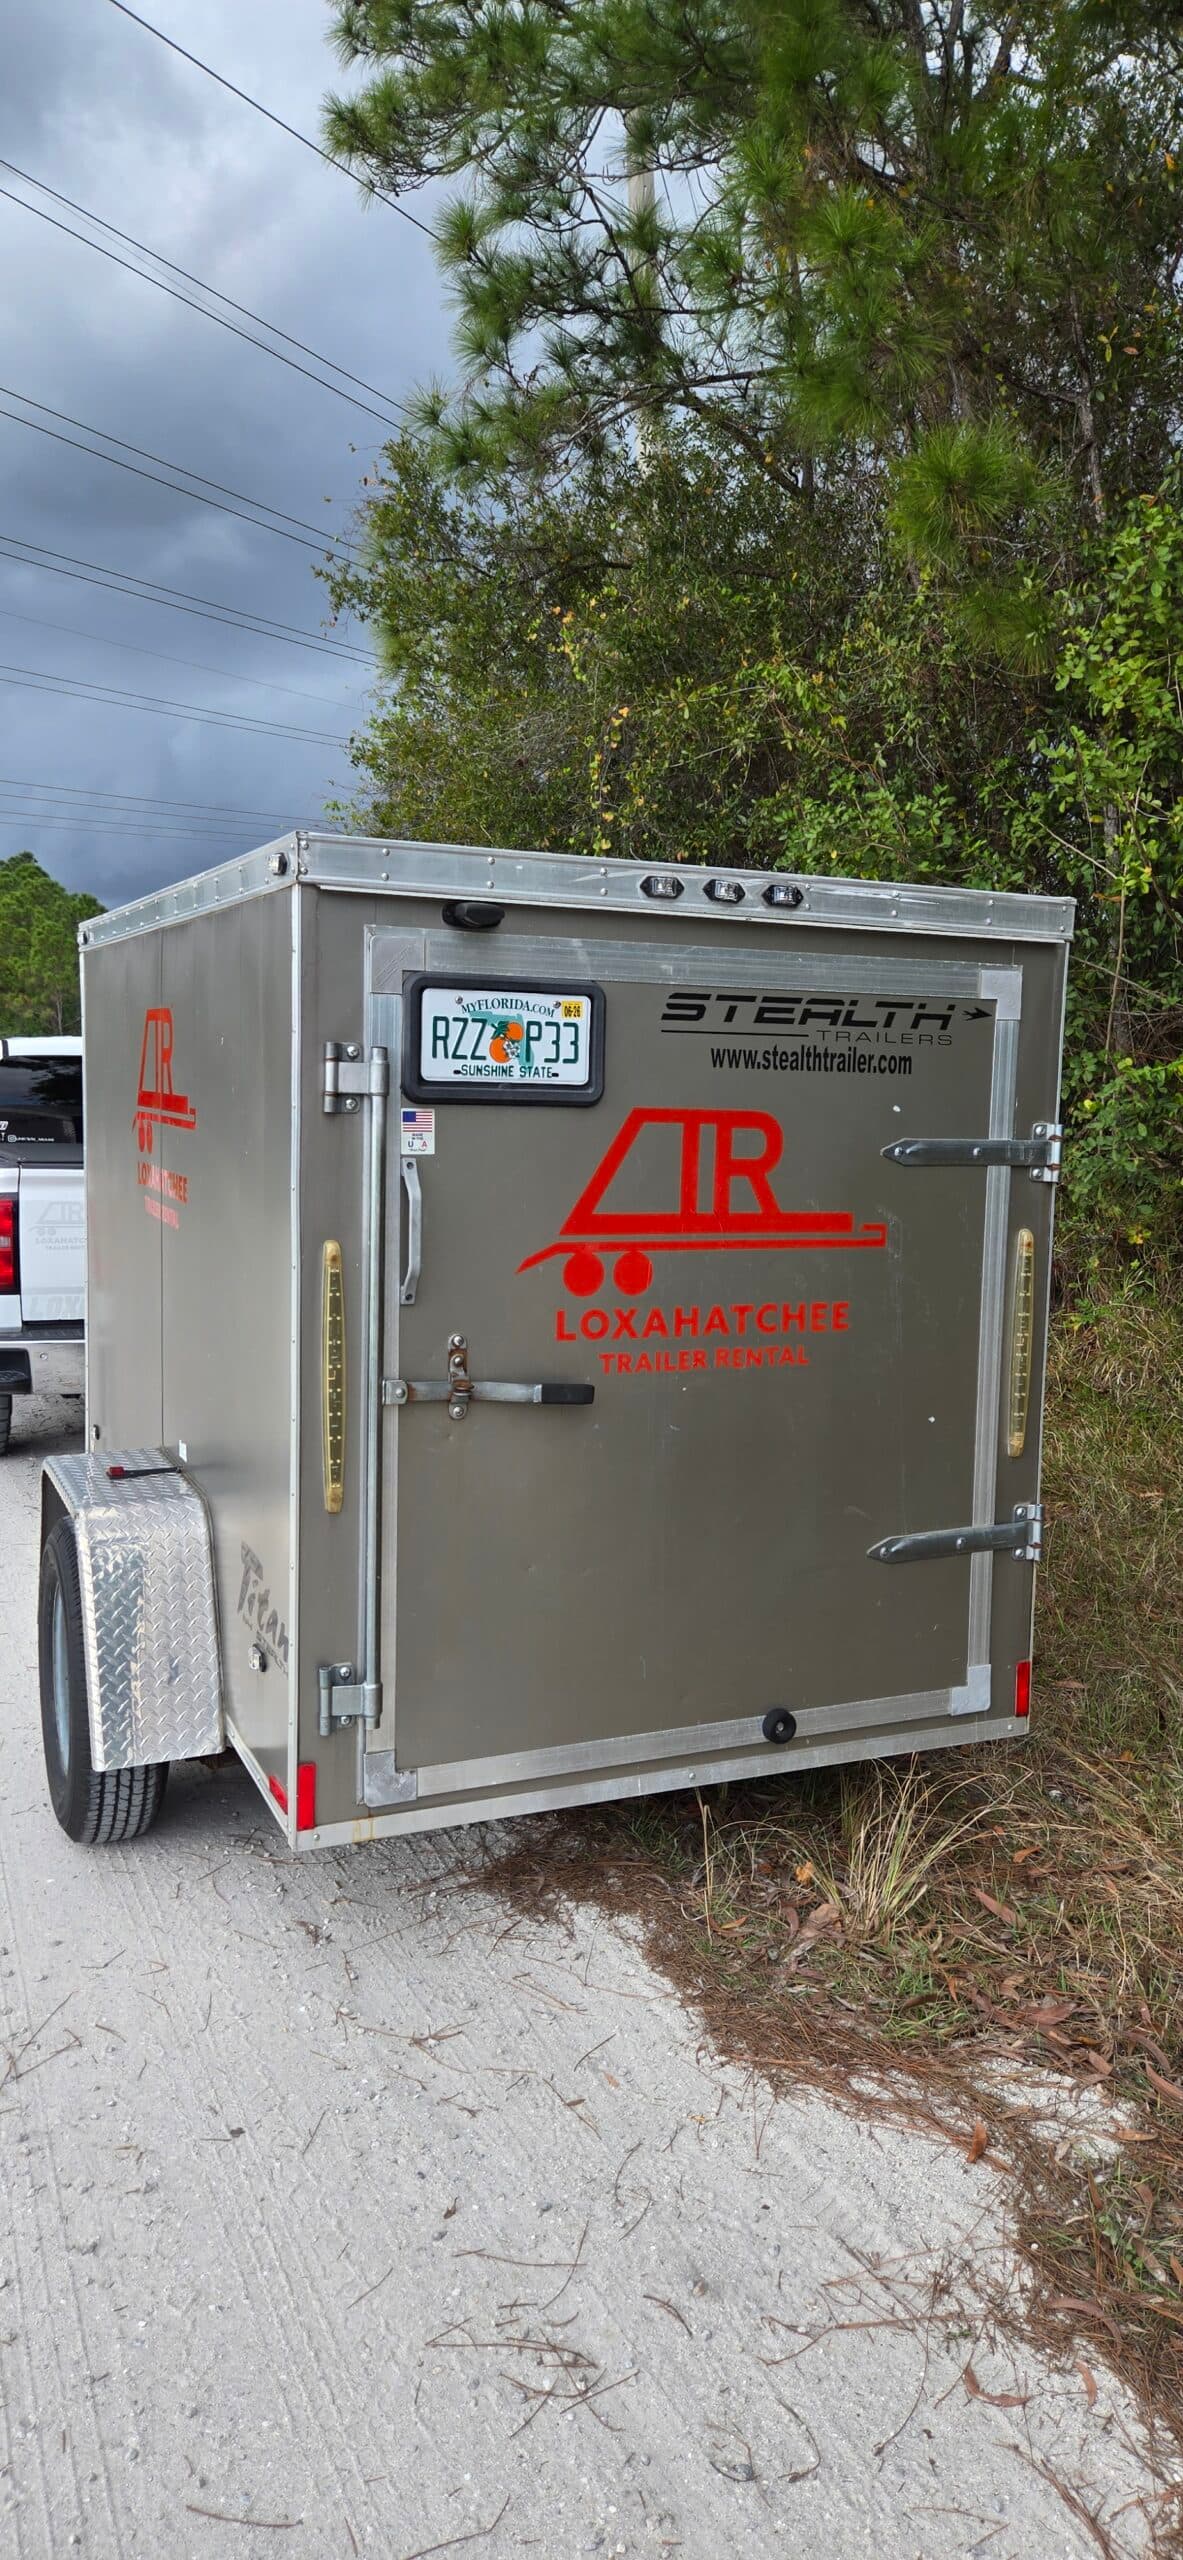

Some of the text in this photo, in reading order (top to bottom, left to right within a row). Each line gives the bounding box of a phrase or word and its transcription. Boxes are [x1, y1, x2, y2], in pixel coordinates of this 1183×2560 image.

[460, 997, 555, 1018] MYFLORIDA.COM
[660, 992, 956, 1031] STEALTH
[431, 1015, 580, 1065] RZZ P33
[816, 1029, 953, 1046] TRAILERS
[461, 1063, 553, 1079] SUNSHINE STATE
[710, 1044, 913, 1075] www.stealthtrailer.com
[555, 1301, 850, 1342] LOXAHATCHEE
[599, 1345, 809, 1375] TRAILER RENTAL
